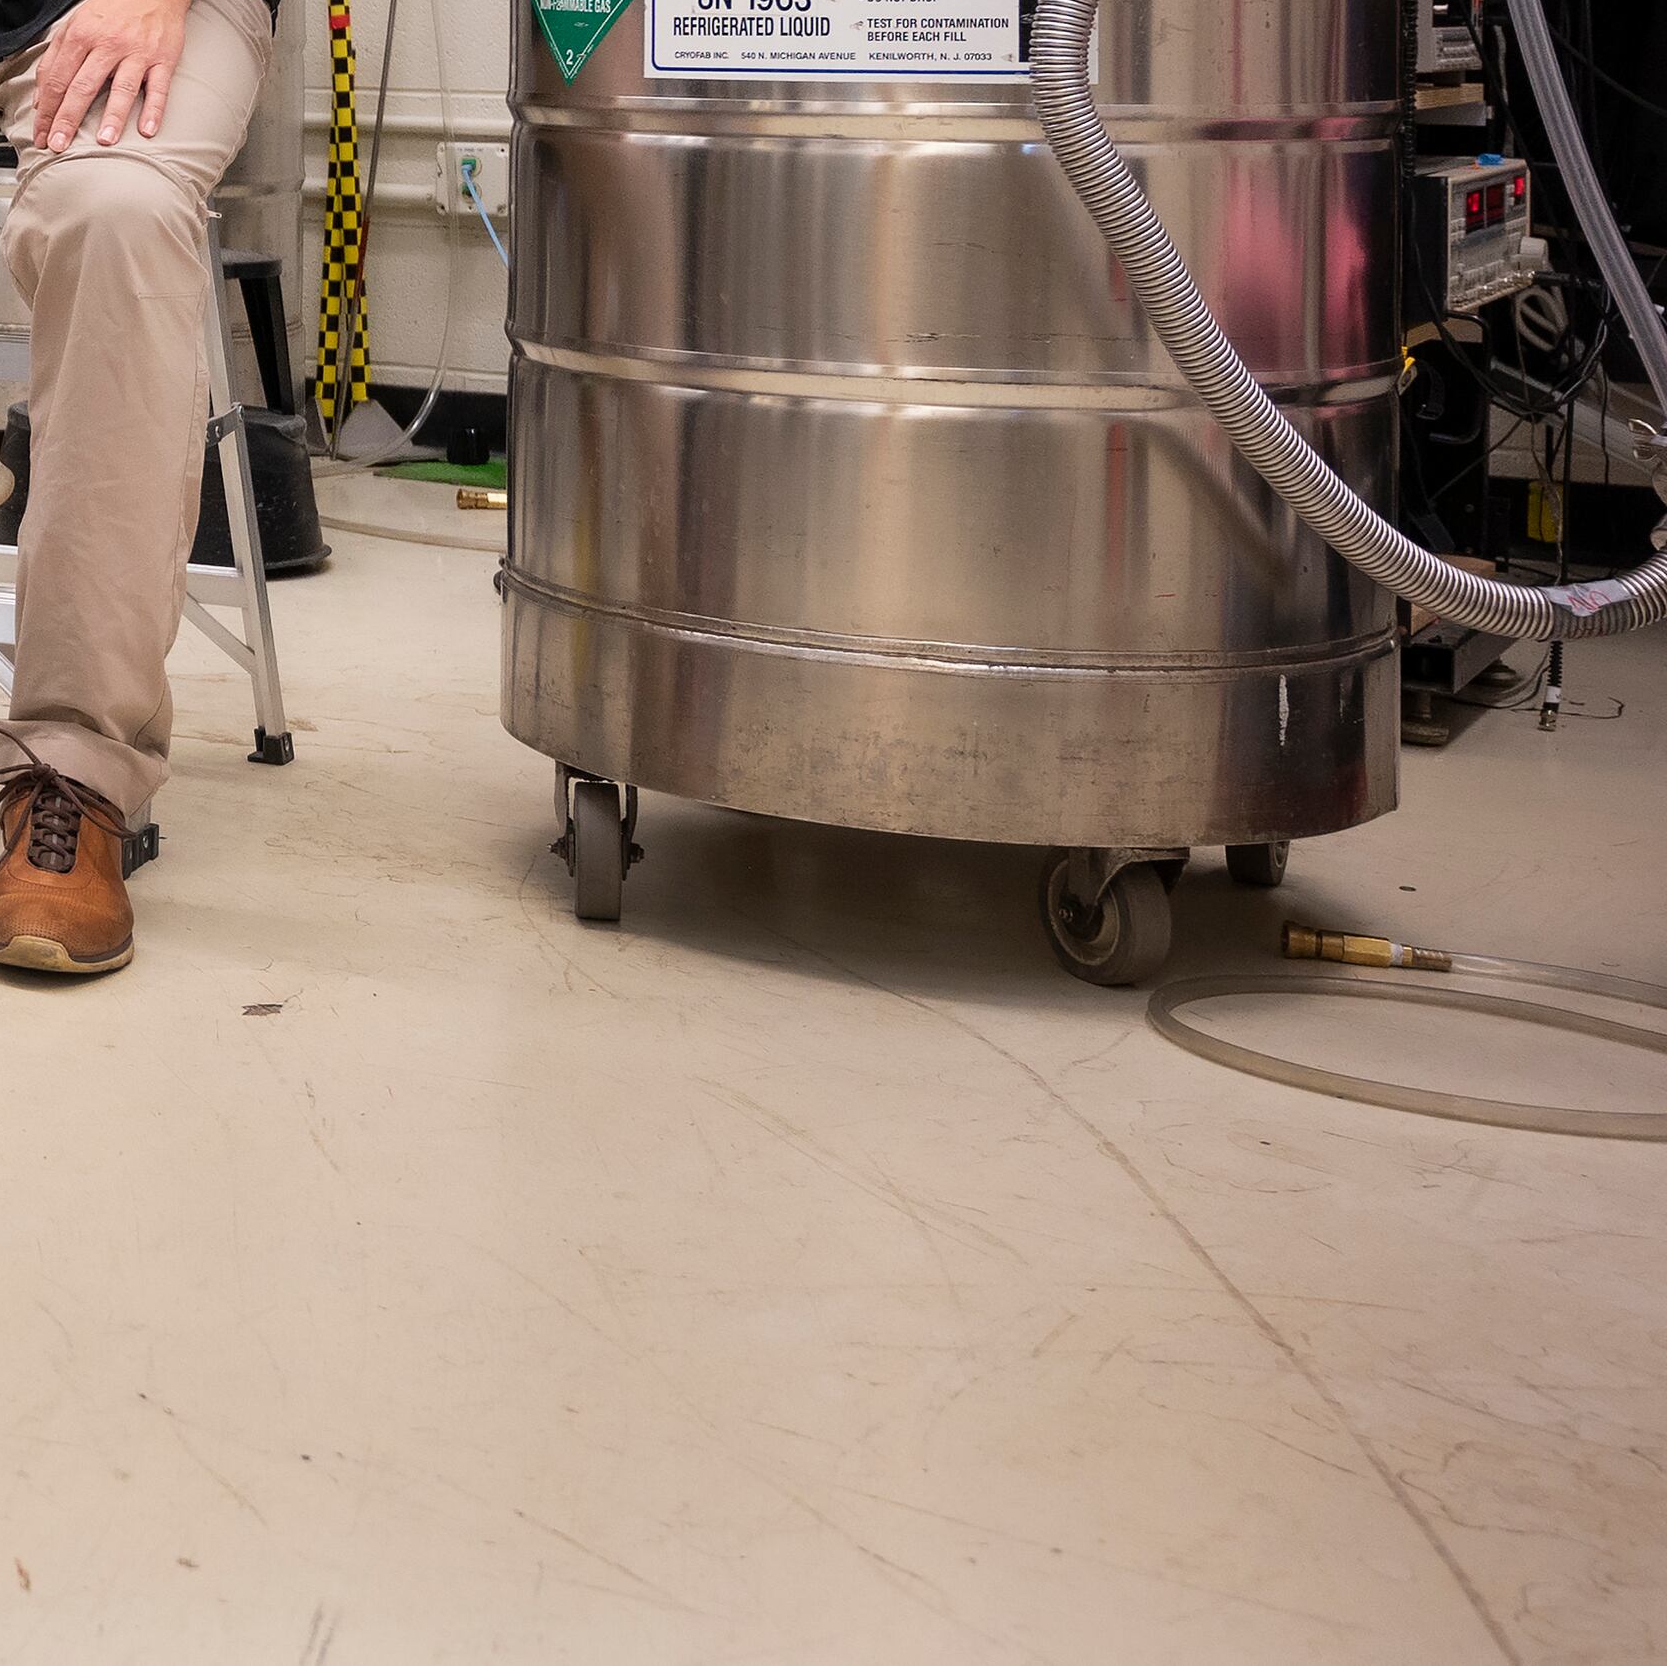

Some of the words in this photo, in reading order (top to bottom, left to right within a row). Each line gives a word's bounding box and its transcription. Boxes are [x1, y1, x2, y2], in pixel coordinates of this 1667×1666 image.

[673, 16, 774, 36] REFRIGERATED
[780, 17, 830, 37] LIQUID
[867, 18, 892, 28] TEST
[896, 18, 917, 28] FOR
[921, 18, 1009, 28] CONTAMINATION
[868, 32, 909, 42] BEFORE
[912, 32, 940, 42] EACH
[944, 32, 967, 42] FILL
[566, 49, 573, 65] 2
[674, 51, 711, 59] CRYOFAB
[741, 52, 756, 60] 540
[758, 52, 768, 60] N.
[770, 52, 816, 60] MICHIGAN
[818, 52, 856, 61] AVENUE
[869, 53, 937, 61] KENILWORTH,
